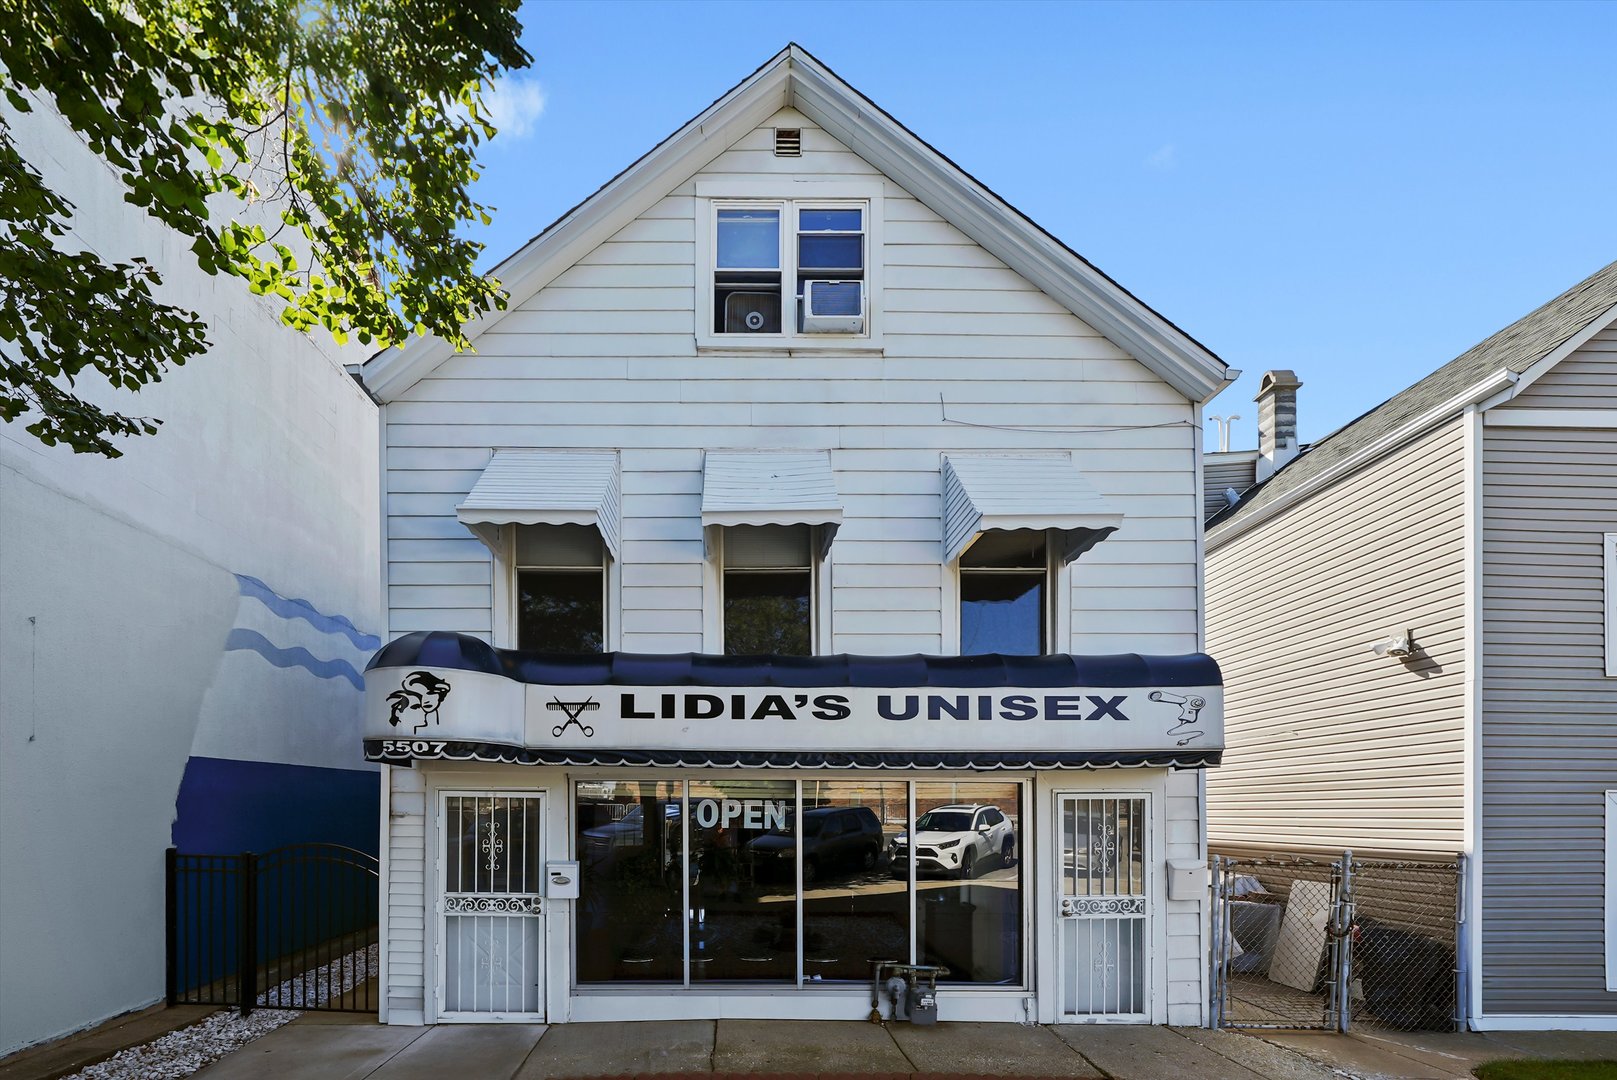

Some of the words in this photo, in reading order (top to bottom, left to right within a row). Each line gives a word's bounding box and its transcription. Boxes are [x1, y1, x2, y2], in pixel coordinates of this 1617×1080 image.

[620, 694, 851, 720] LIDIA'S
[877, 695, 1130, 721] UNISEX
[382, 741, 447, 753] 5507
[697, 799, 786, 830] OPEN
